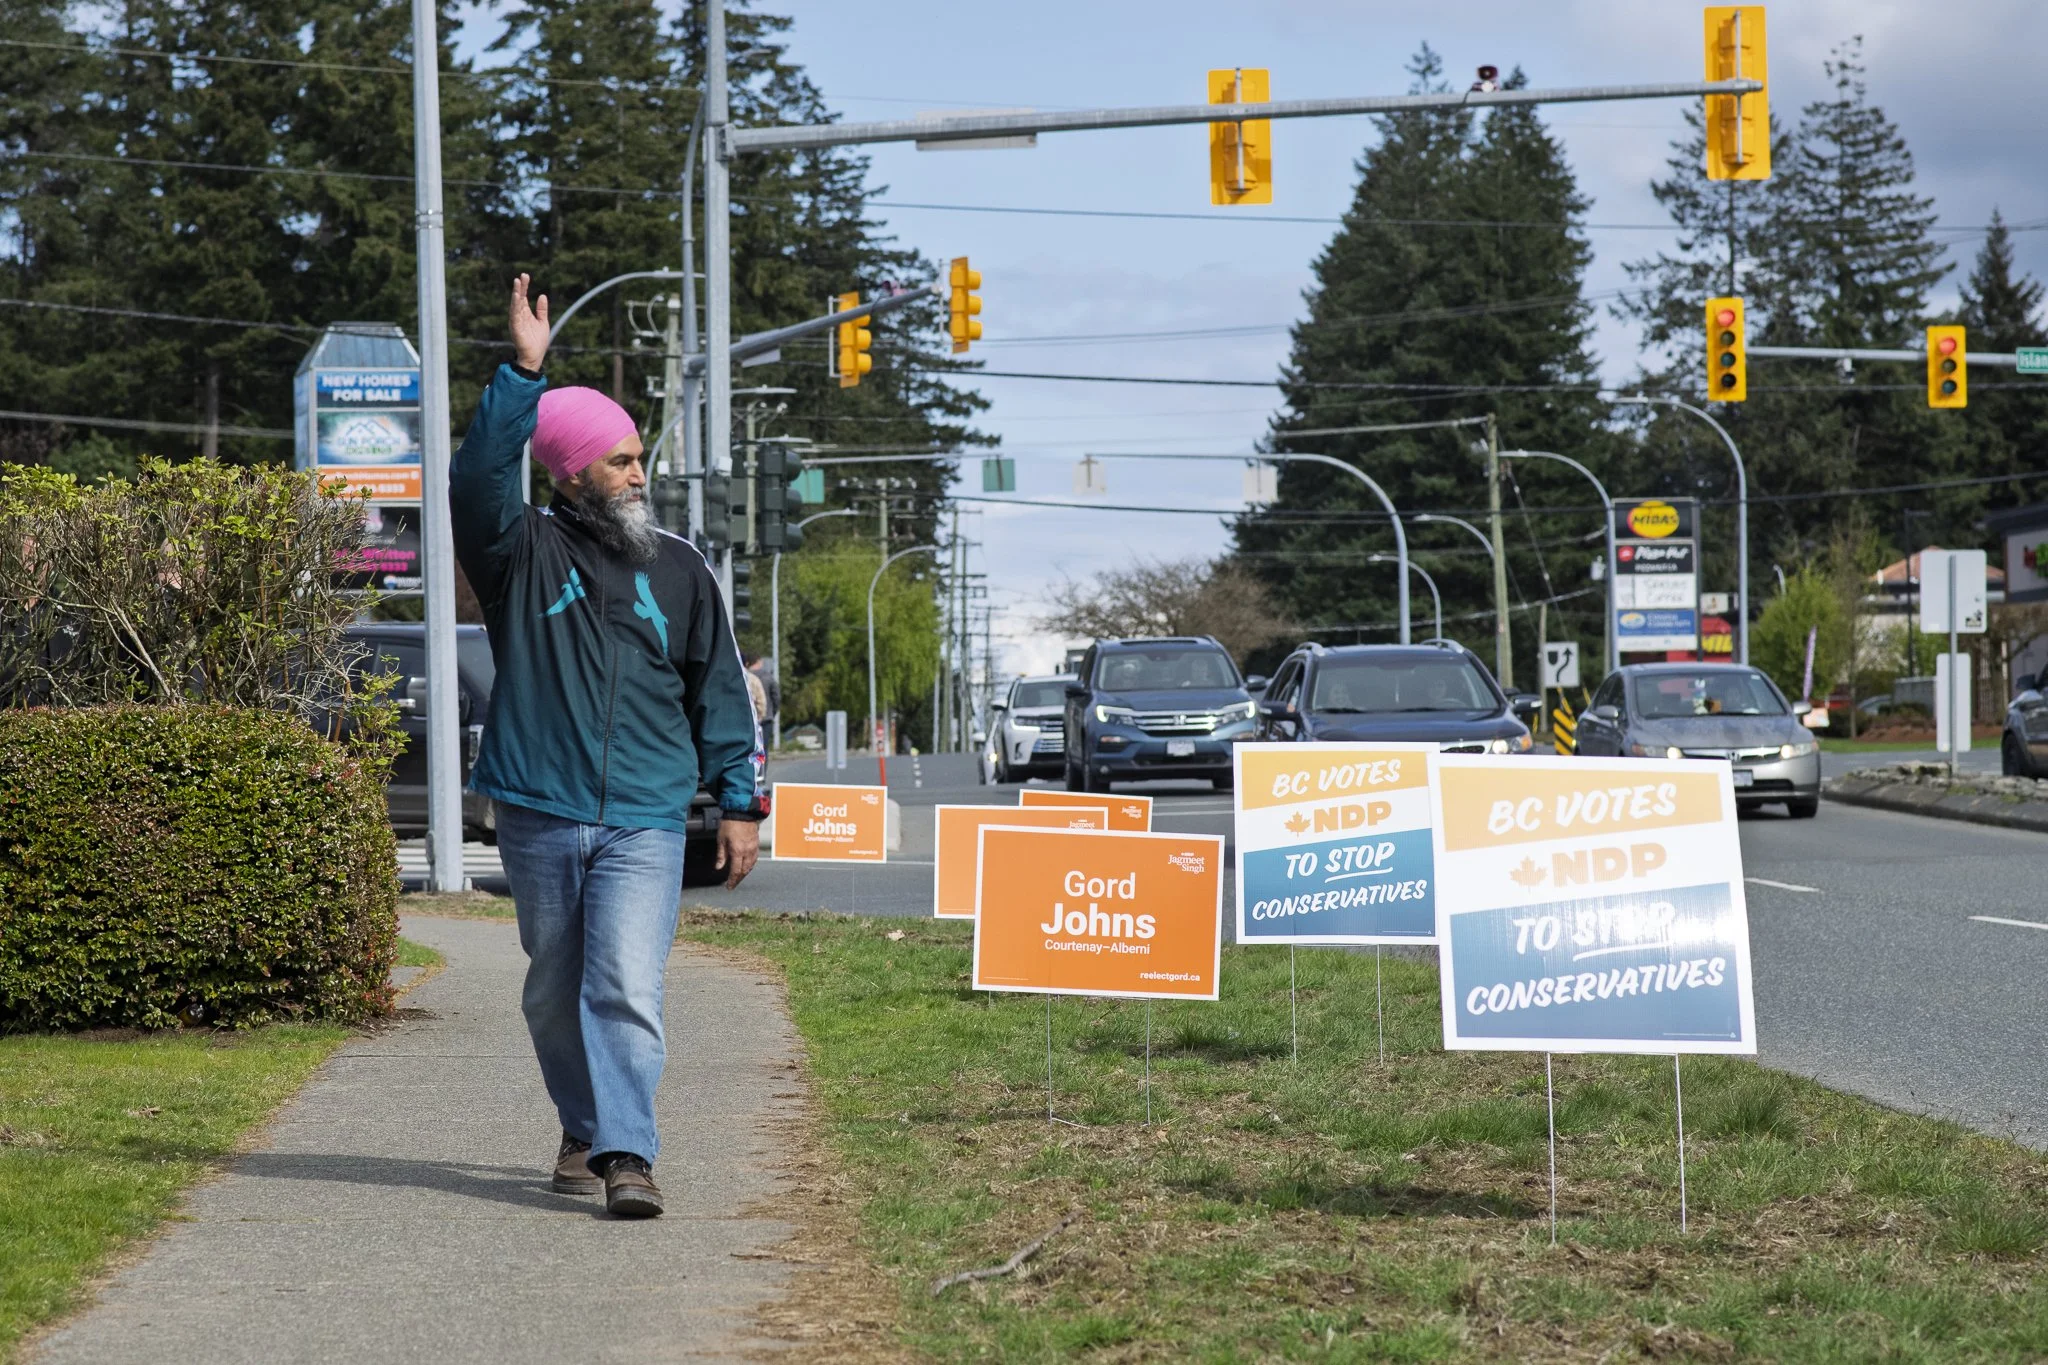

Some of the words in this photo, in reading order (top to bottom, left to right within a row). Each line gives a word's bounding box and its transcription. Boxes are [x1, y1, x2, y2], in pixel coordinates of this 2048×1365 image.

[322, 375, 356, 387] NEW
[358, 374, 411, 387] HOMES
[332, 388, 362, 401] FOR
[365, 388, 401, 401] SALE
[1633, 515, 1677, 524] MIDAS
[1272, 771, 1310, 799] BC
[1318, 758, 1402, 792] VOTES
[813, 803, 848, 817] Gord
[1314, 801, 1392, 833] NDP
[1487, 797, 1543, 835] BC
[1555, 782, 1677, 828] VOTES
[802, 818, 857, 836] Johns
[1168, 854, 1205, 867] Jagmeet
[1182, 864, 1205, 875] Singh
[1285, 852, 1318, 880] TO
[1325, 842, 1396, 873] STOP
[1551, 842, 1667, 888] NDP
[1064, 870, 1136, 900] Gord
[1252, 879, 1428, 921] CONSERVATIVES
[1041, 903, 1156, 939] Johns
[1513, 916, 1561, 955] TO
[1140, 971, 1201, 982] reelectgord.ca
[1466, 957, 1726, 1016] CONSERVATIVES
